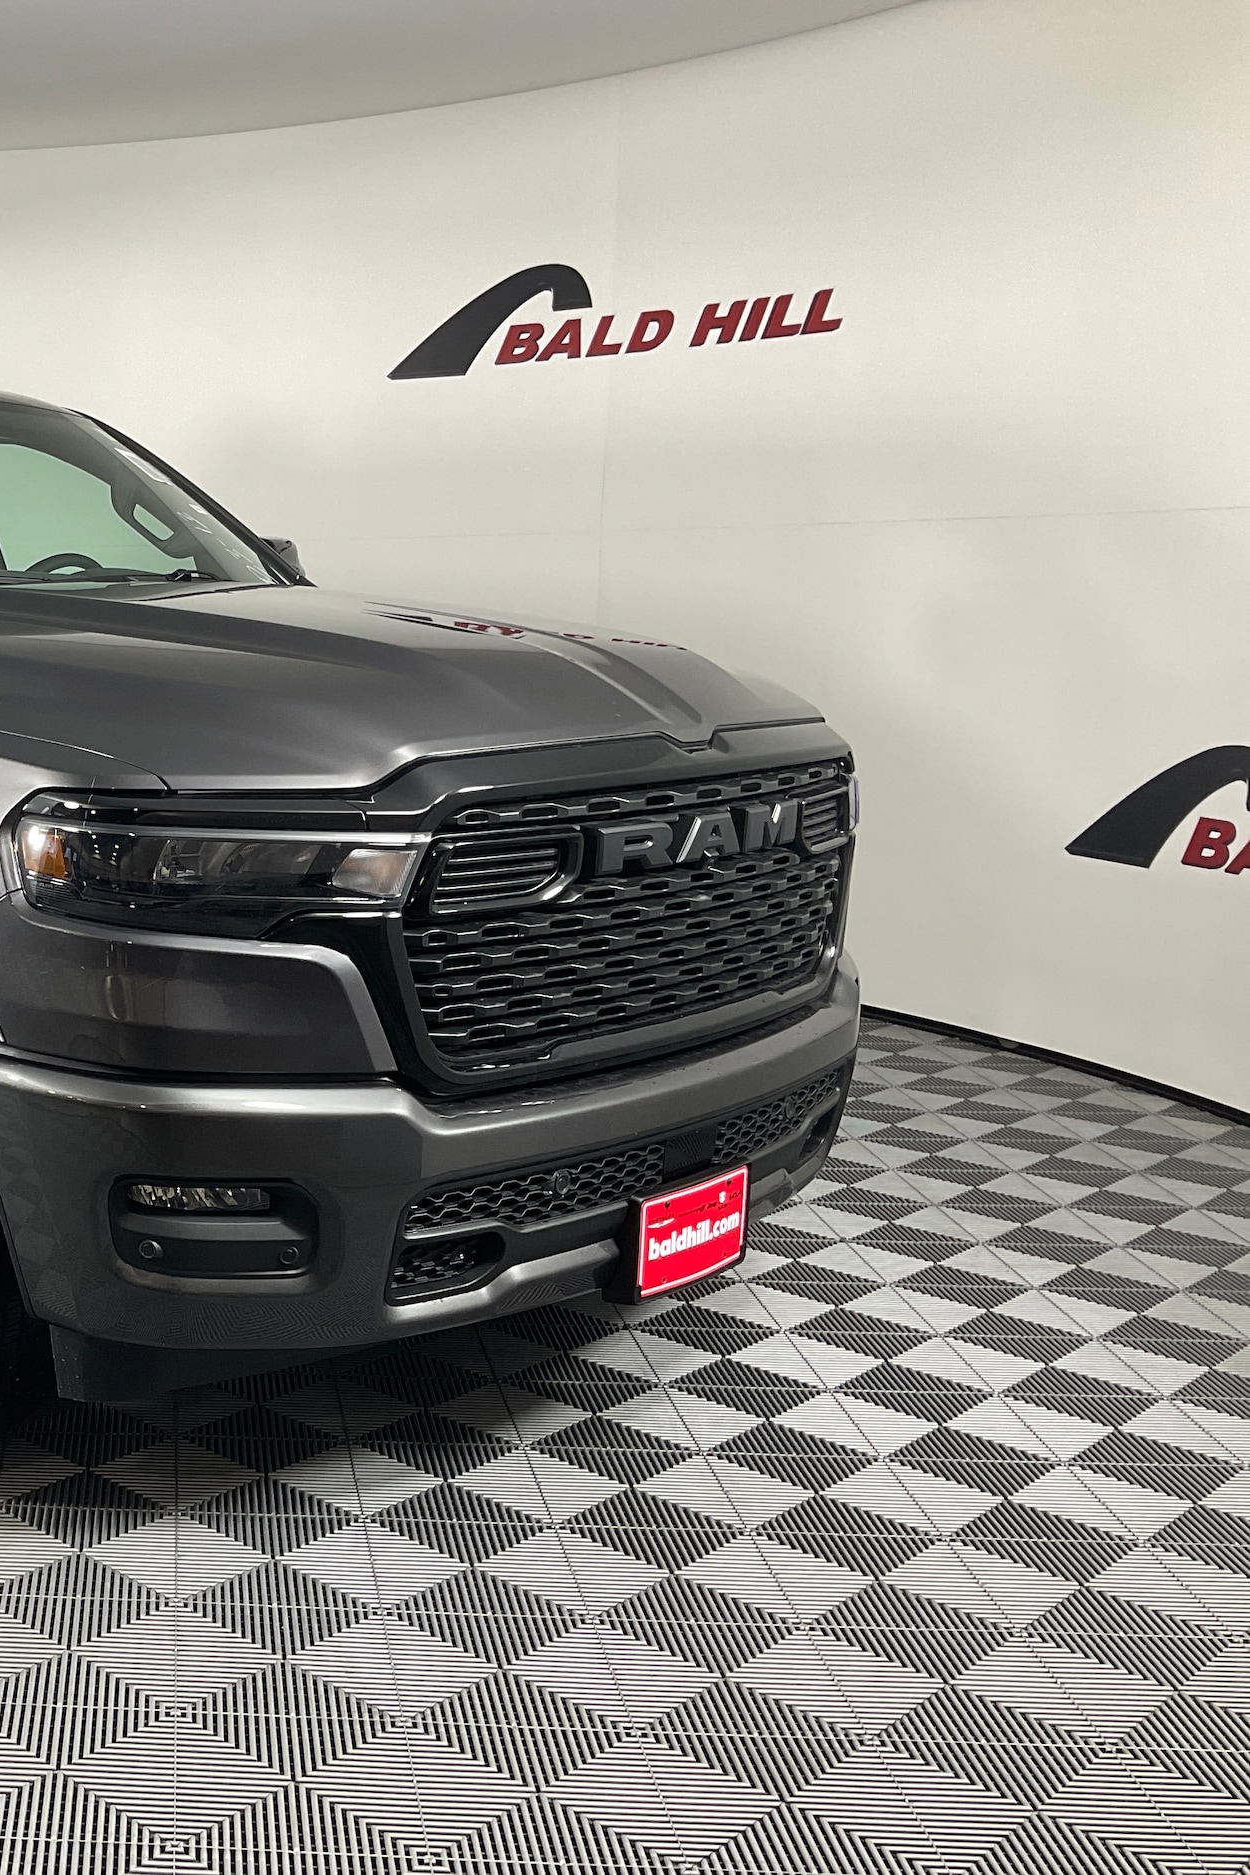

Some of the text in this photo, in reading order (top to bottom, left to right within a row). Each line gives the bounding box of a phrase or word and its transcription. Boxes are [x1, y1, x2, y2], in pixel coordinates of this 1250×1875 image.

[495, 287, 843, 365] BALD HILL
[592, 799, 800, 876] RAM
[648, 1211, 740, 1261] baldhill.com
